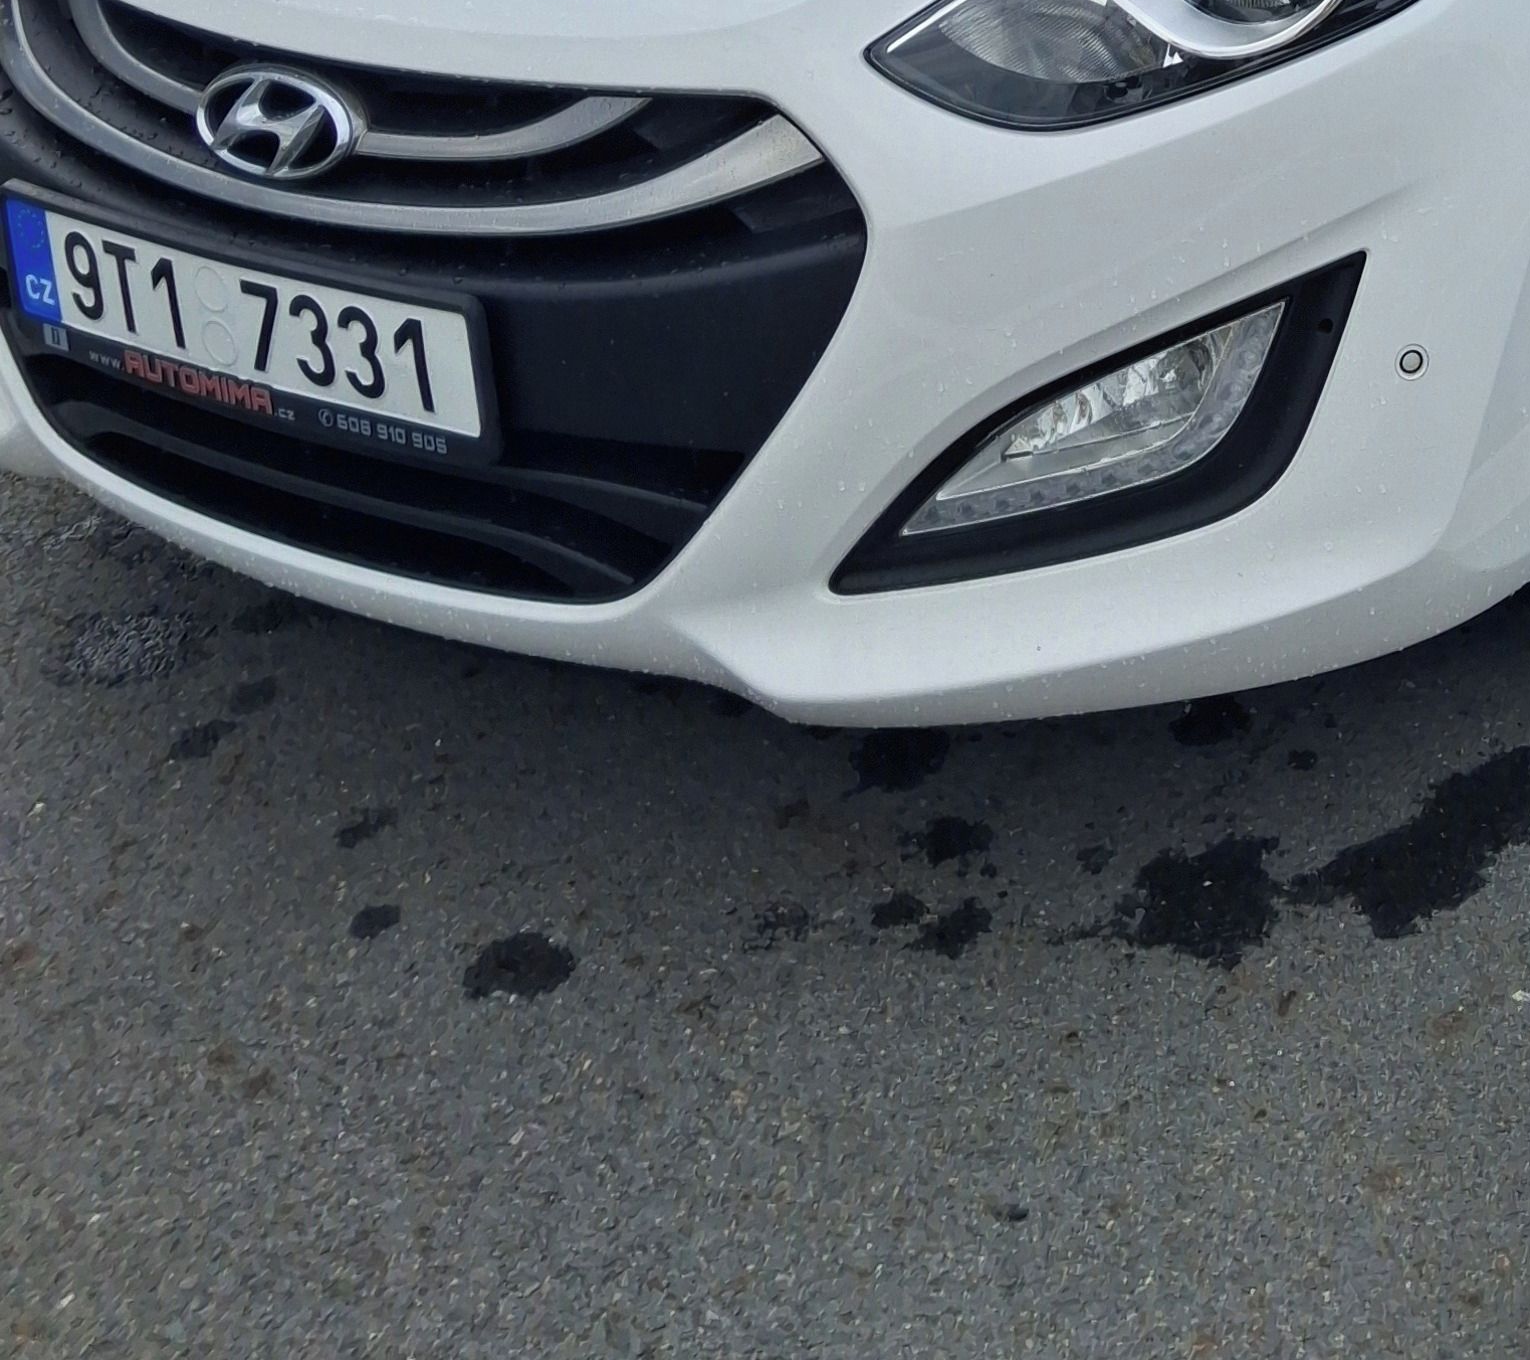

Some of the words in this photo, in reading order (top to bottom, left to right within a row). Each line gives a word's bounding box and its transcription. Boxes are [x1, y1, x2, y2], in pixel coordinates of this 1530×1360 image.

[25, 273, 56, 306] CZ
[64, 230, 187, 350] 9T1
[239, 279, 437, 414] 7331
[336, 413, 372, 437] 608
[376, 423, 407, 445] 910
